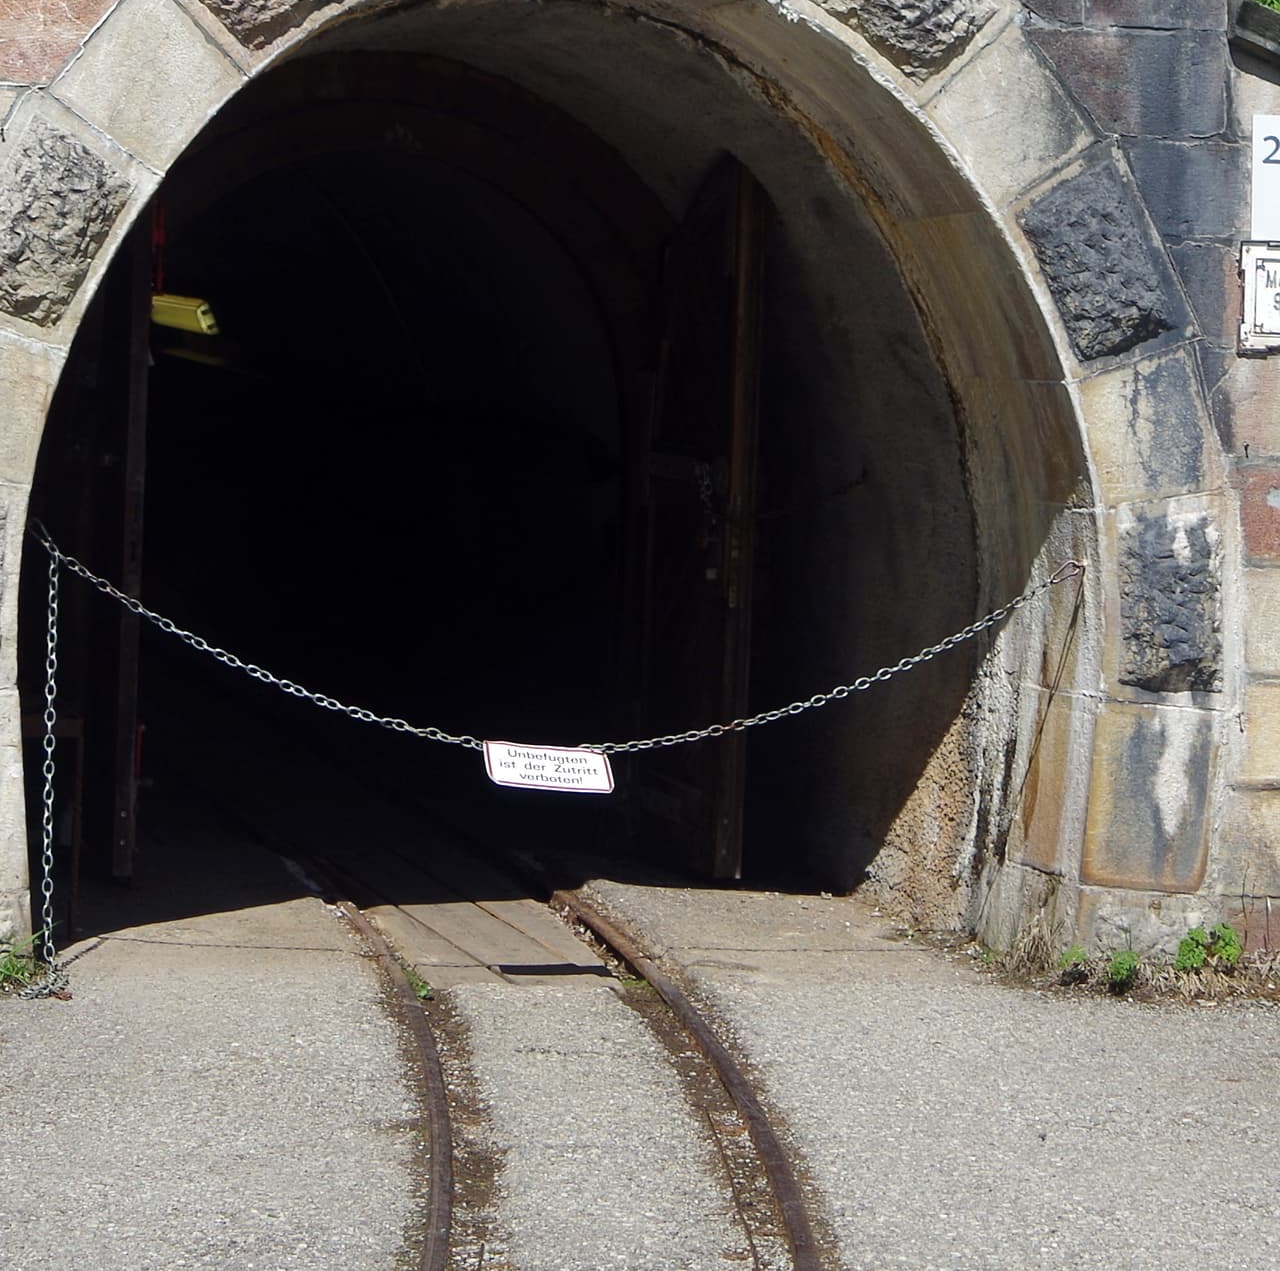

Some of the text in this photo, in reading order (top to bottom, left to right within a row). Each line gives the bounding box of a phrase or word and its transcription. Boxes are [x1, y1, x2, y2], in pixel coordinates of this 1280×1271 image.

[507, 748, 588, 765] Unbefugten
[499, 759, 599, 776] ist der Zutritt
[519, 773, 584, 785] verboten!
